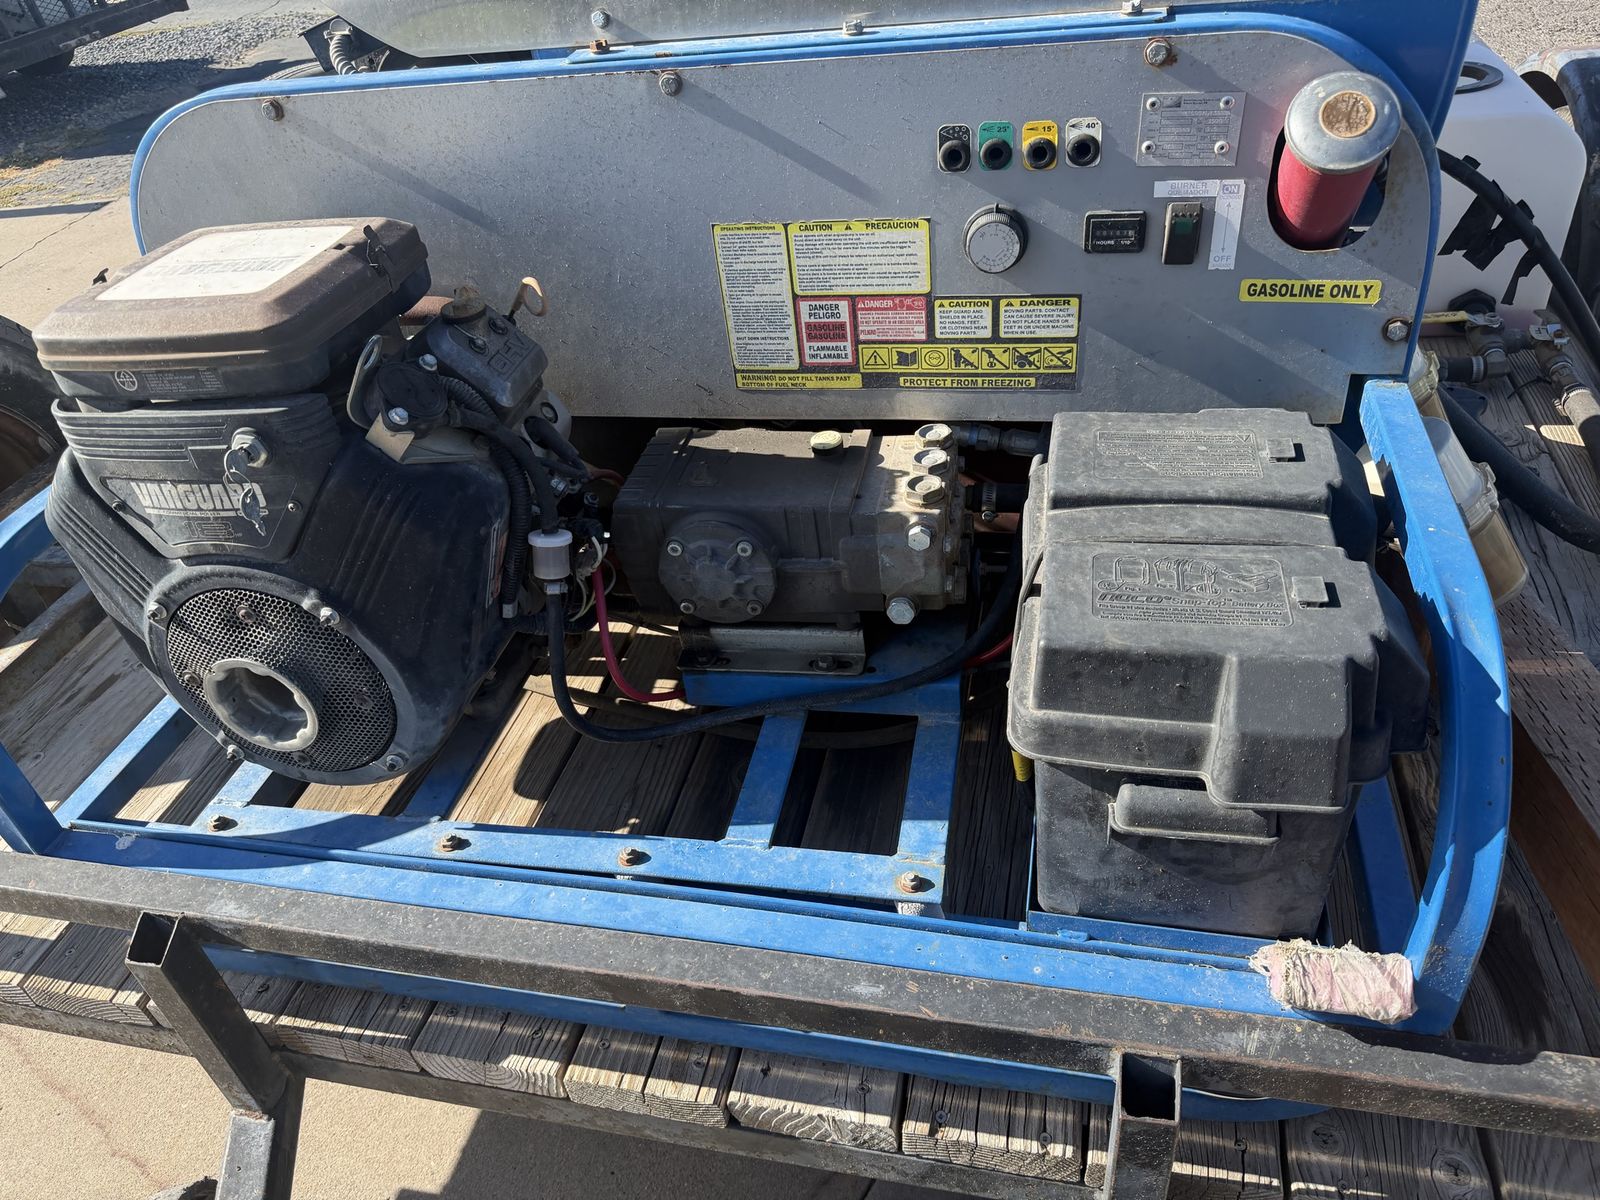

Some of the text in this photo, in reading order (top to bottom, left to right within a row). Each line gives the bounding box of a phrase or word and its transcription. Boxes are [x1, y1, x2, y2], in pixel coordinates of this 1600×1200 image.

[1223, 185, 1238, 193] ON
[1247, 283, 1374, 298] GASOLINE ONLY
